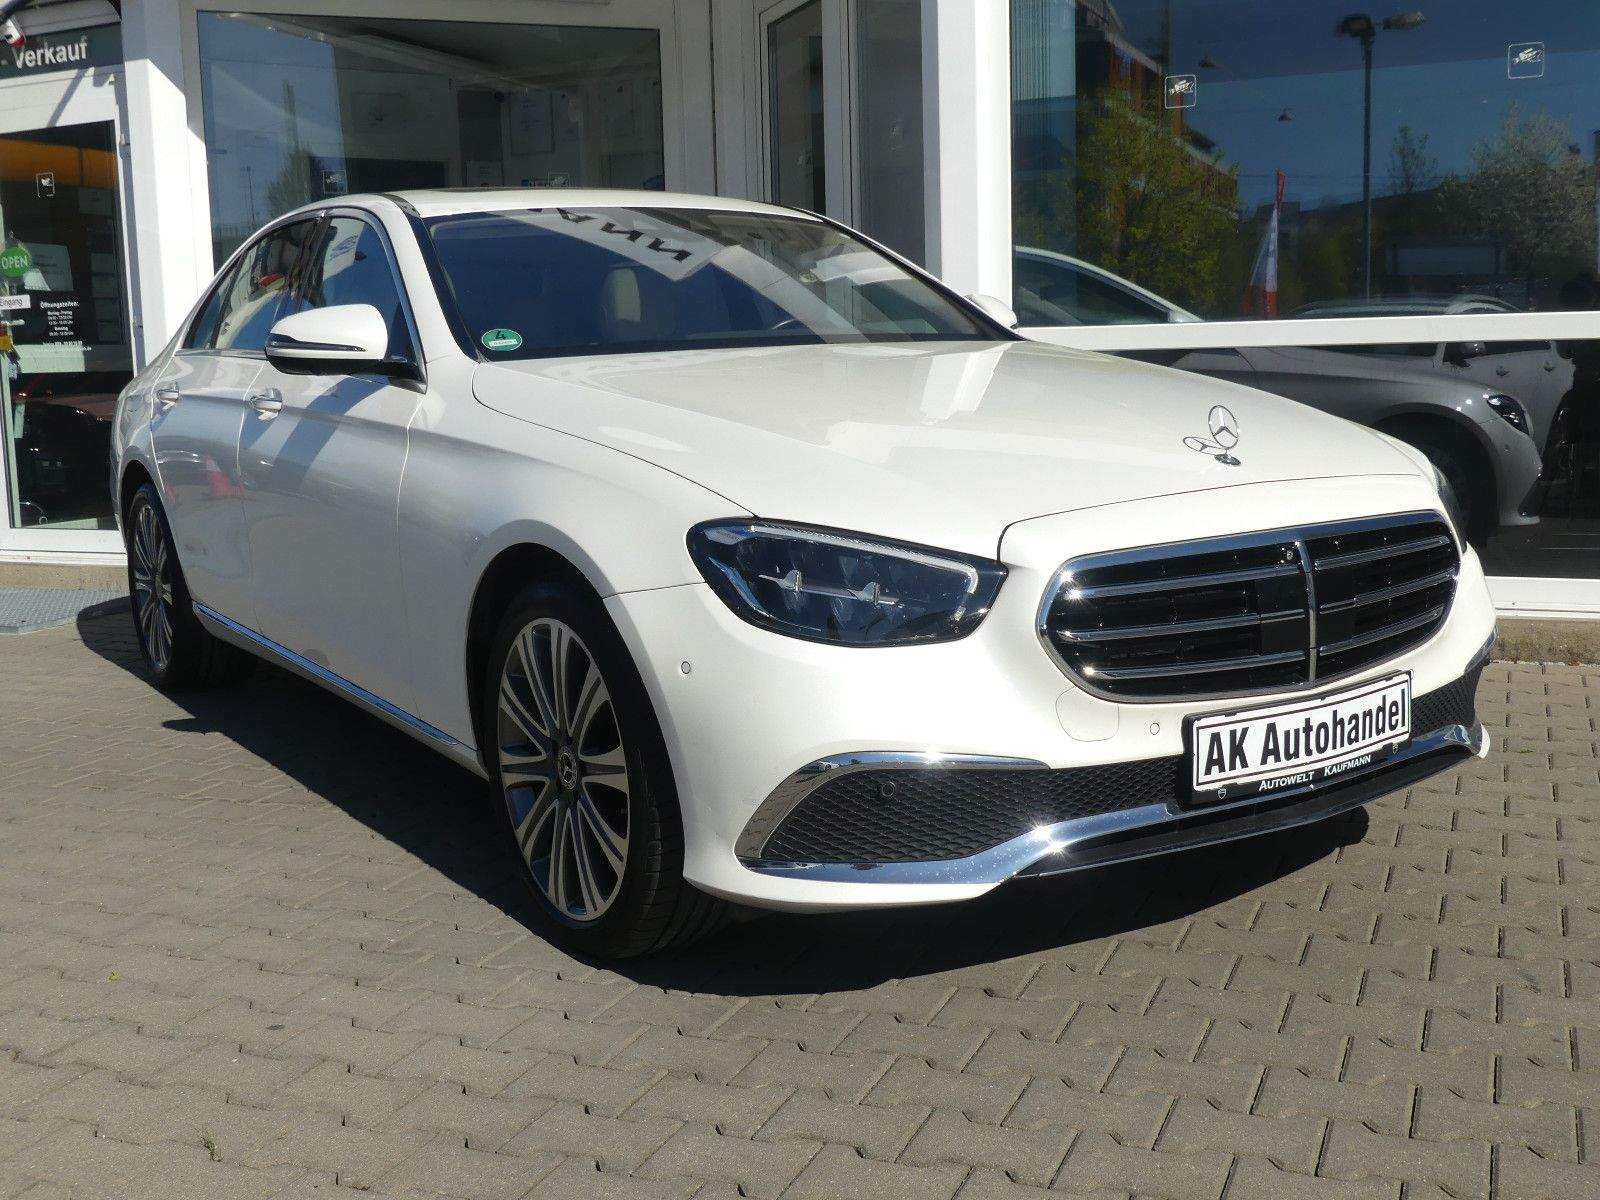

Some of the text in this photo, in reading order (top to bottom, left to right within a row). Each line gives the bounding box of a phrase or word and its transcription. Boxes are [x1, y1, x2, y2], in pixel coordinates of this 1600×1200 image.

[12, 36, 88, 69] Verkauf
[1, 255, 28, 270] OPEN
[1203, 688, 1407, 776] AK Autohandel
[1259, 755, 1372, 791] AUTOWELT KAUFMANN
